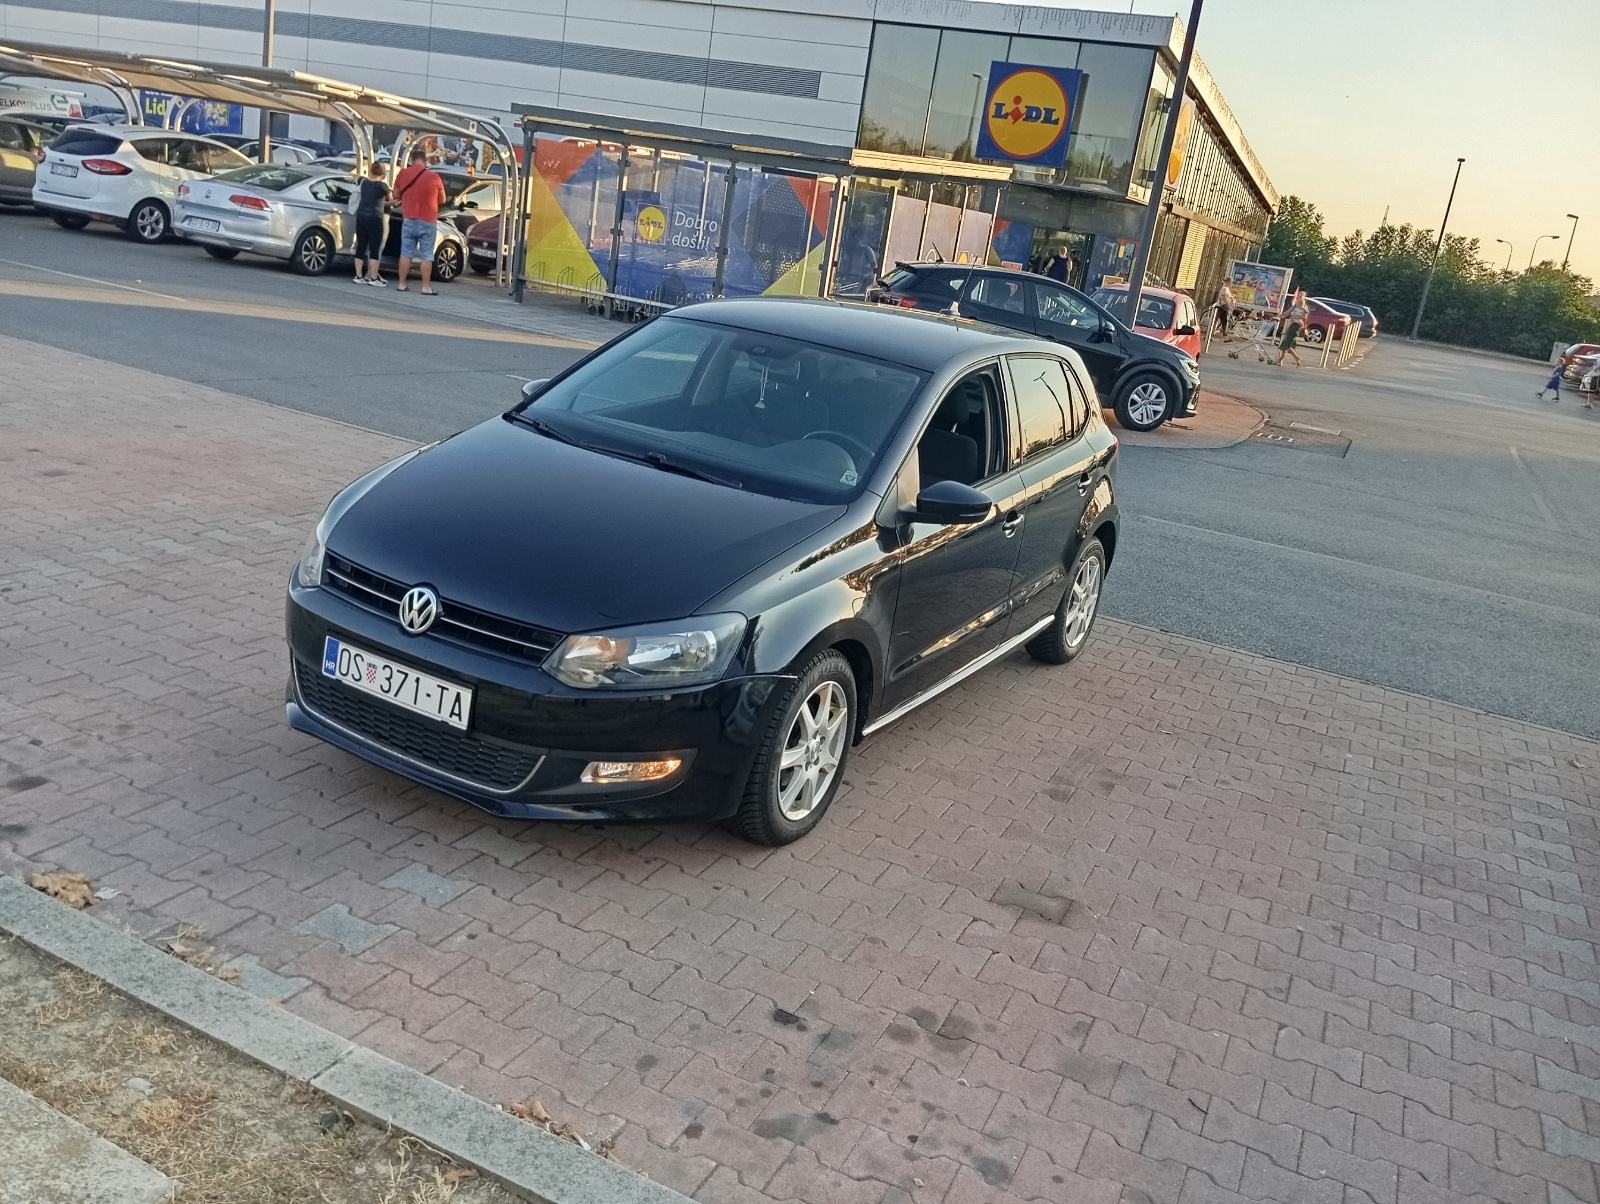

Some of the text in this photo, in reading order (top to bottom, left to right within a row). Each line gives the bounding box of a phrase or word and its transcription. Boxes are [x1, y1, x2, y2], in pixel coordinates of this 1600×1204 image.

[145, 97, 169, 116] Lid
[674, 211, 718, 232] Dobro
[325, 659, 336, 672] HR
[338, 648, 462, 722] OS 371-TA
